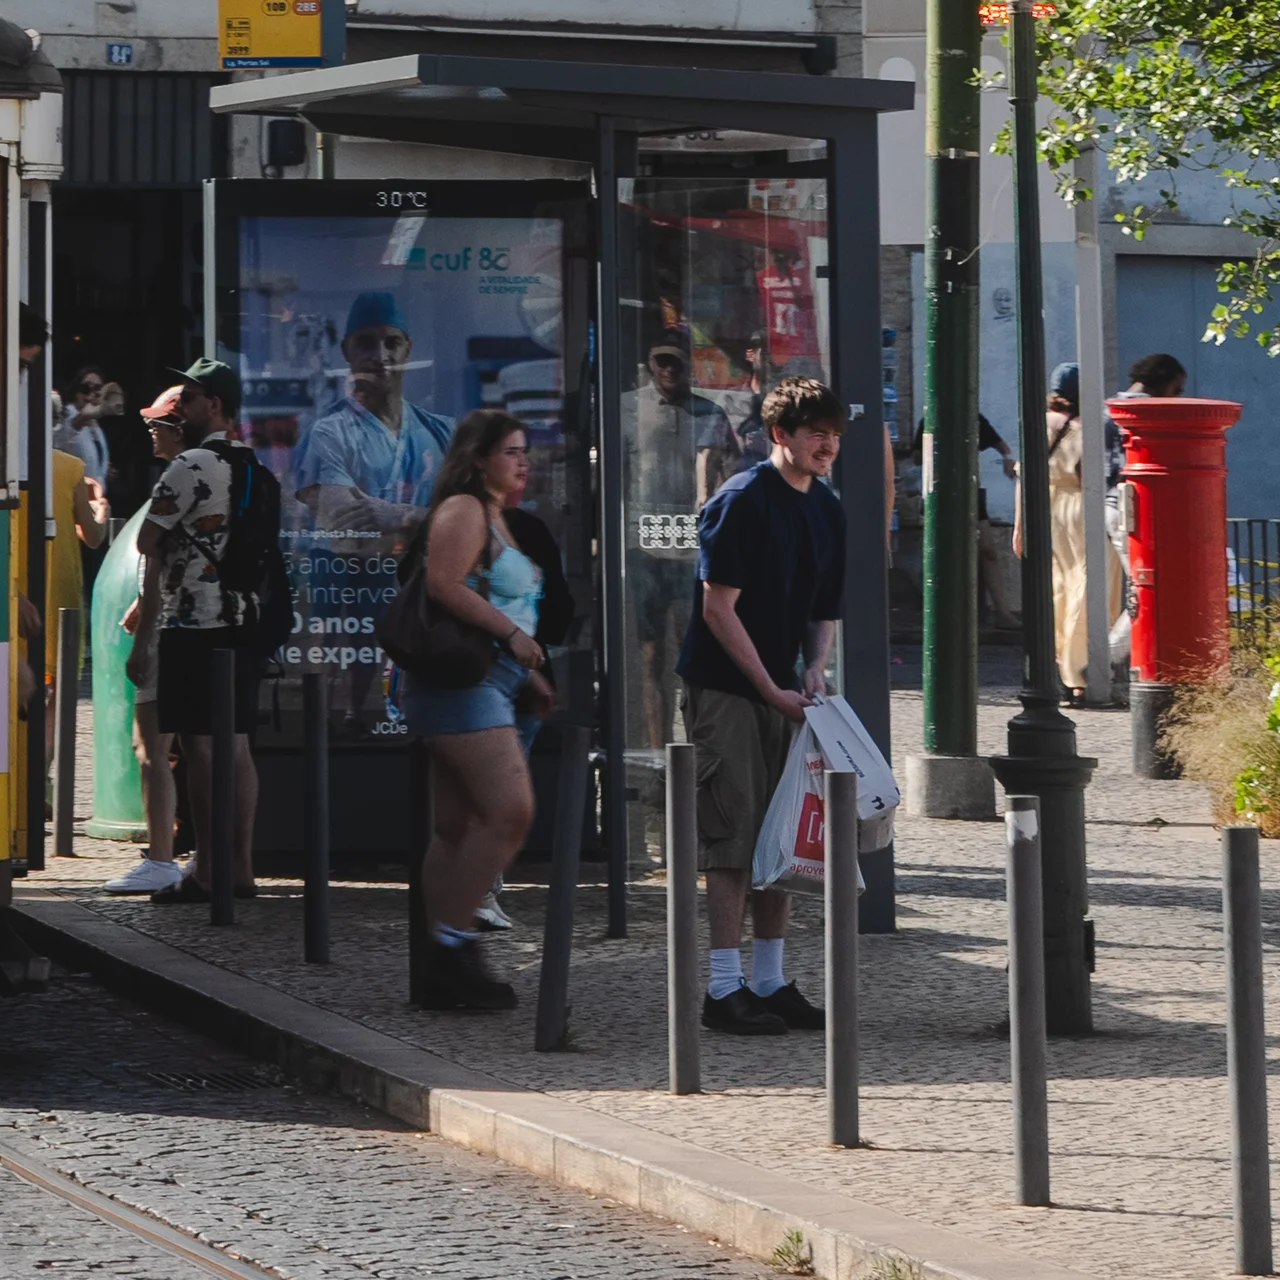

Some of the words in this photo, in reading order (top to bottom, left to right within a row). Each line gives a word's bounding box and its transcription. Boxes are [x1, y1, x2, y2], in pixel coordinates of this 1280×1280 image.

[297, 2, 317, 12] 28E
[430, 247, 472, 271] cuf
[301, 529, 344, 540] Baptista
[347, 529, 382, 538] Ramos
[299, 557, 360, 574] anos
[365, 552, 398, 574] de
[308, 616, 375, 634] anos
